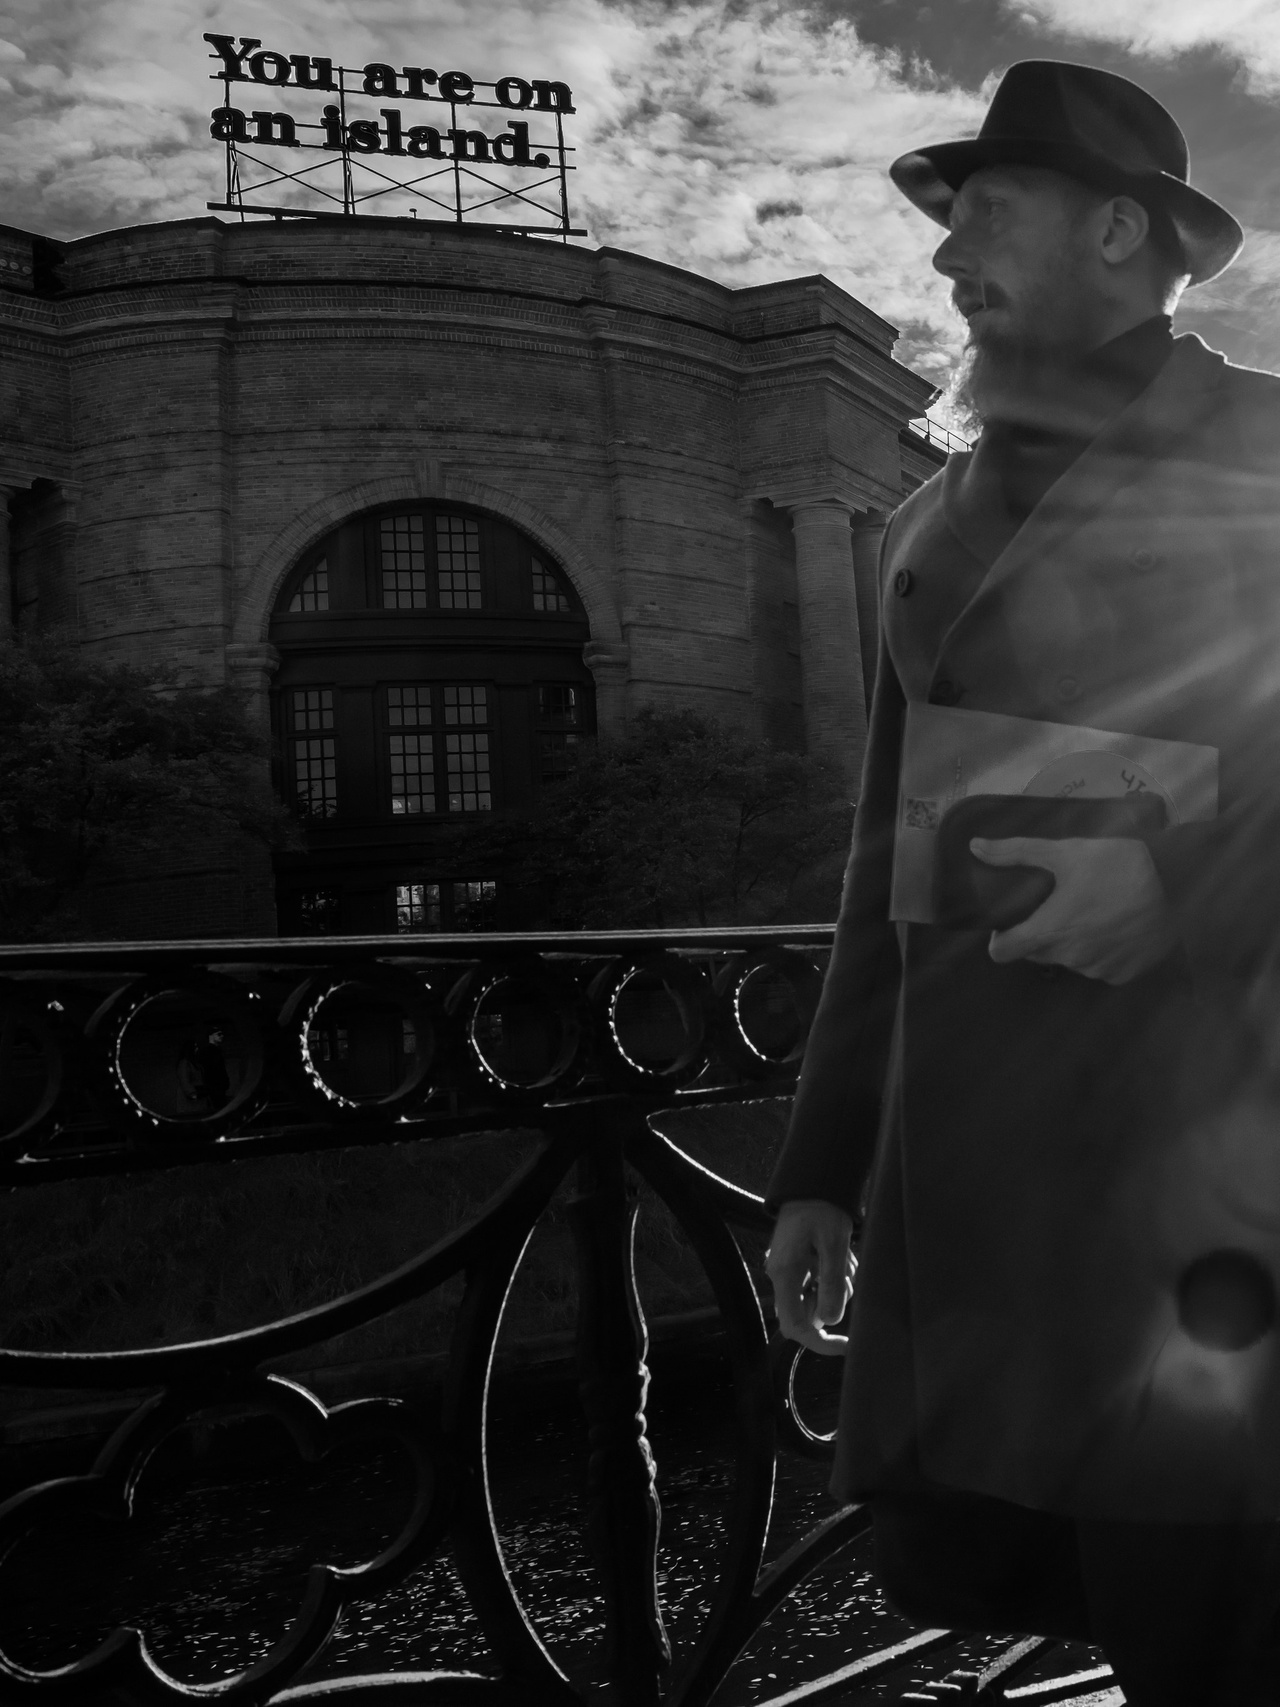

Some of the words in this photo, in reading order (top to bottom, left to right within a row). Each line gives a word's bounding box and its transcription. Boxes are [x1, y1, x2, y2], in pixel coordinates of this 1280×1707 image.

[203, 33, 337, 90] You
[363, 62, 475, 104] are
[495, 76, 576, 114] on
[210, 107, 300, 147] an
[321, 105, 550, 168] island.
